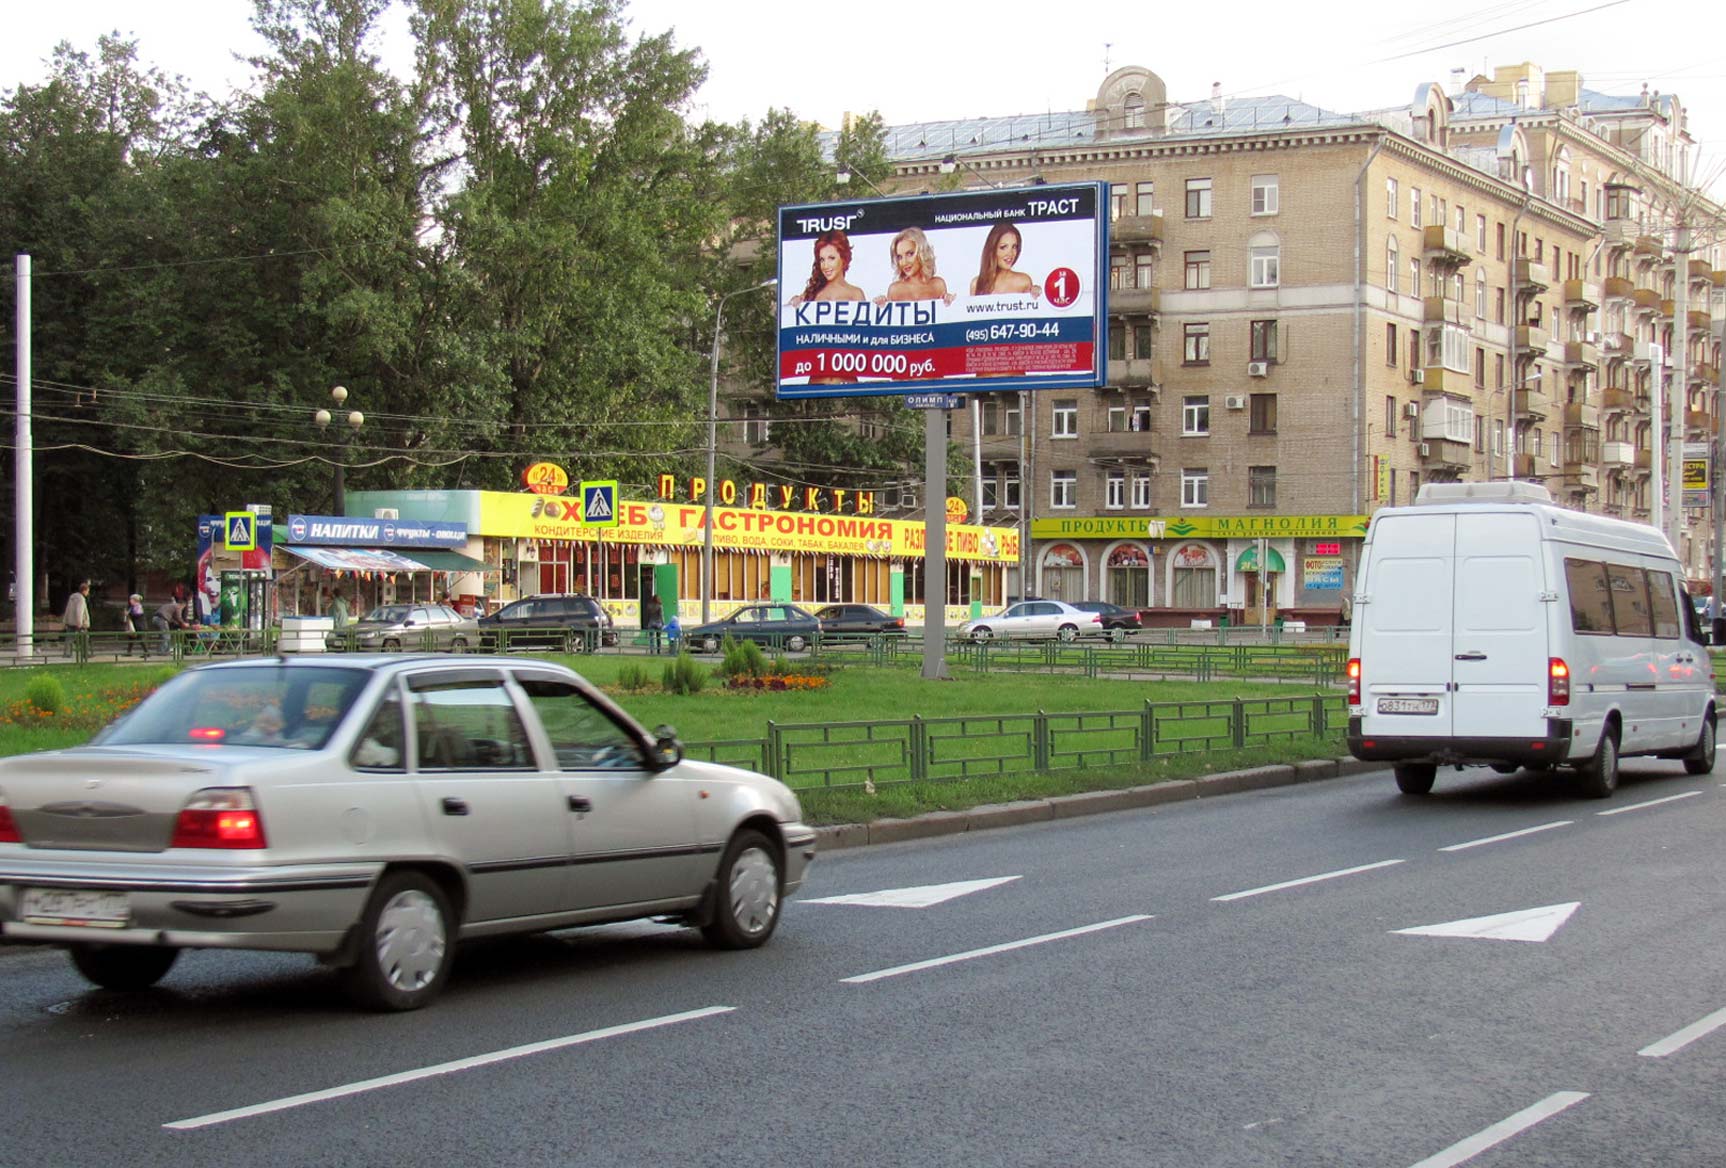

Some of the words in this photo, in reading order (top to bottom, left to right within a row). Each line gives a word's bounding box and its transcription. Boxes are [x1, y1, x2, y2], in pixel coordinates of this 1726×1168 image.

[935, 209, 1002, 223] НАЦИОНАЛЬНЫЙ
[1004, 209, 1026, 218] БАНК
[1028, 198, 1080, 216] ТРАСТ
[1054, 277, 1065, 298] 1
[795, 301, 936, 326] КРЕДИТЫ
[966, 300, 1039, 313] www.trust.ru
[796, 333, 861, 345] НАЛИЧНЫМИ
[870, 336, 889, 346] для
[890, 332, 935, 345] БИЗНЕСА
[965, 328, 989, 342] (495)
[990, 322, 1060, 339] 647-90-44
[795, 361, 812, 374] до
[817, 353, 825, 372] 1
[832, 353, 867, 372] 000
[872, 354, 907, 373] 000
[910, 359, 936, 376] руб.
[659, 474, 873, 514] ПРОДУКТЫ
[561, 500, 648, 526] ХБ
[310, 523, 380, 539] НАПИТКИ
[618, 529, 664, 540] ИЗДЕЛИЯ
[680, 508, 893, 540] ГАСТРОНОМИЯ
[1218, 518, 1338, 530] МАГНОЛИЯ
[828, 541, 865, 551] БАКАЛЕЯ
[957, 531, 978, 553] ПИВО
